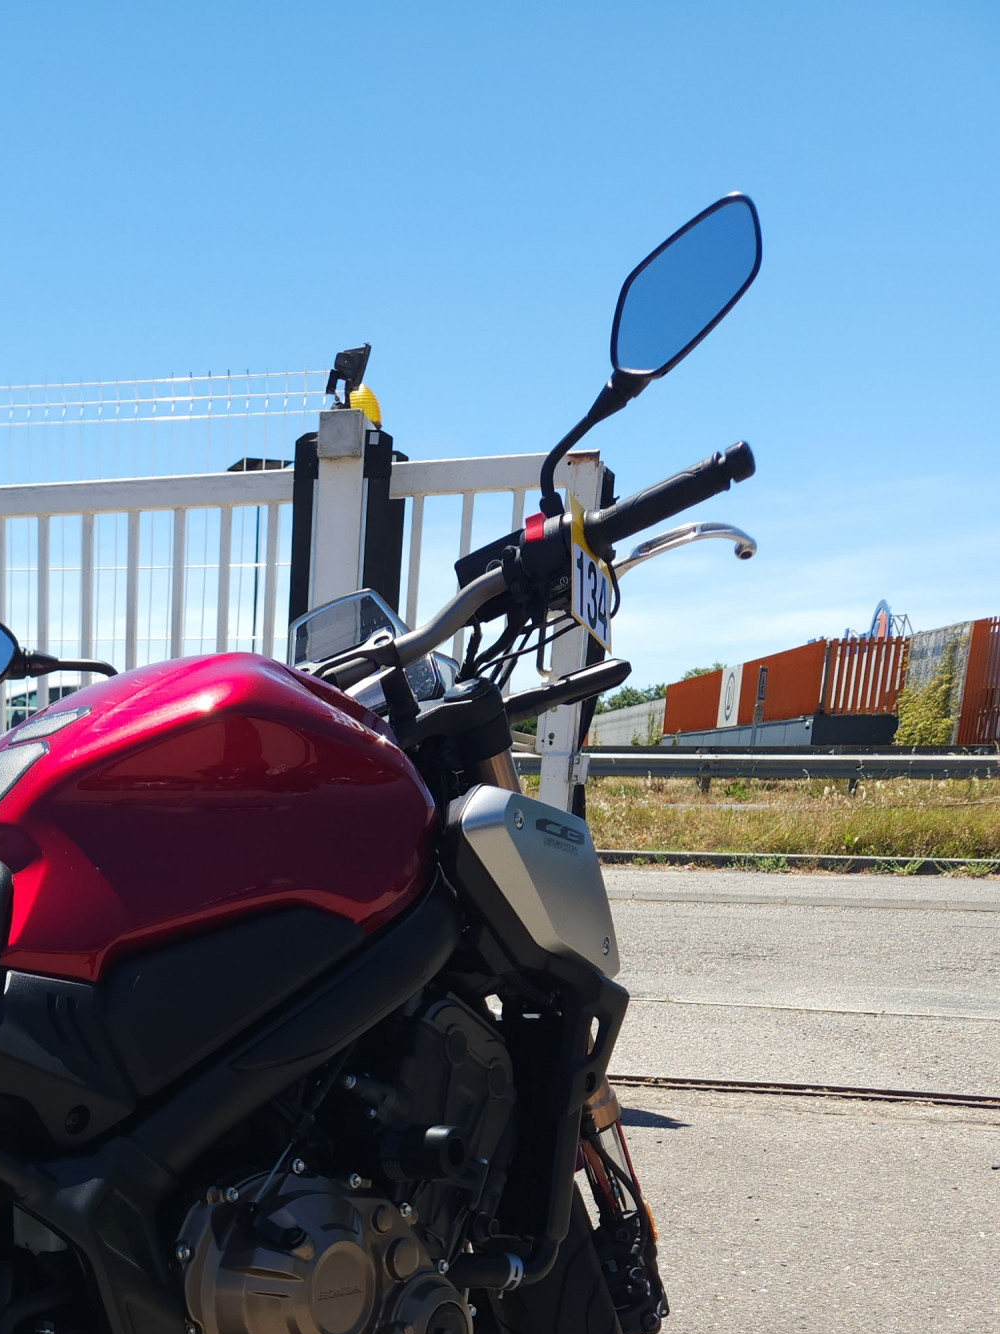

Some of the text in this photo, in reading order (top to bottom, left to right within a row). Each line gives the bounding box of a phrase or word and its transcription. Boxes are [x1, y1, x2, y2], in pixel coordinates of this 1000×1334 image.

[577, 551, 607, 641] 134
[536, 818, 584, 845] CB
[317, 1285, 362, 1301] HONDA
